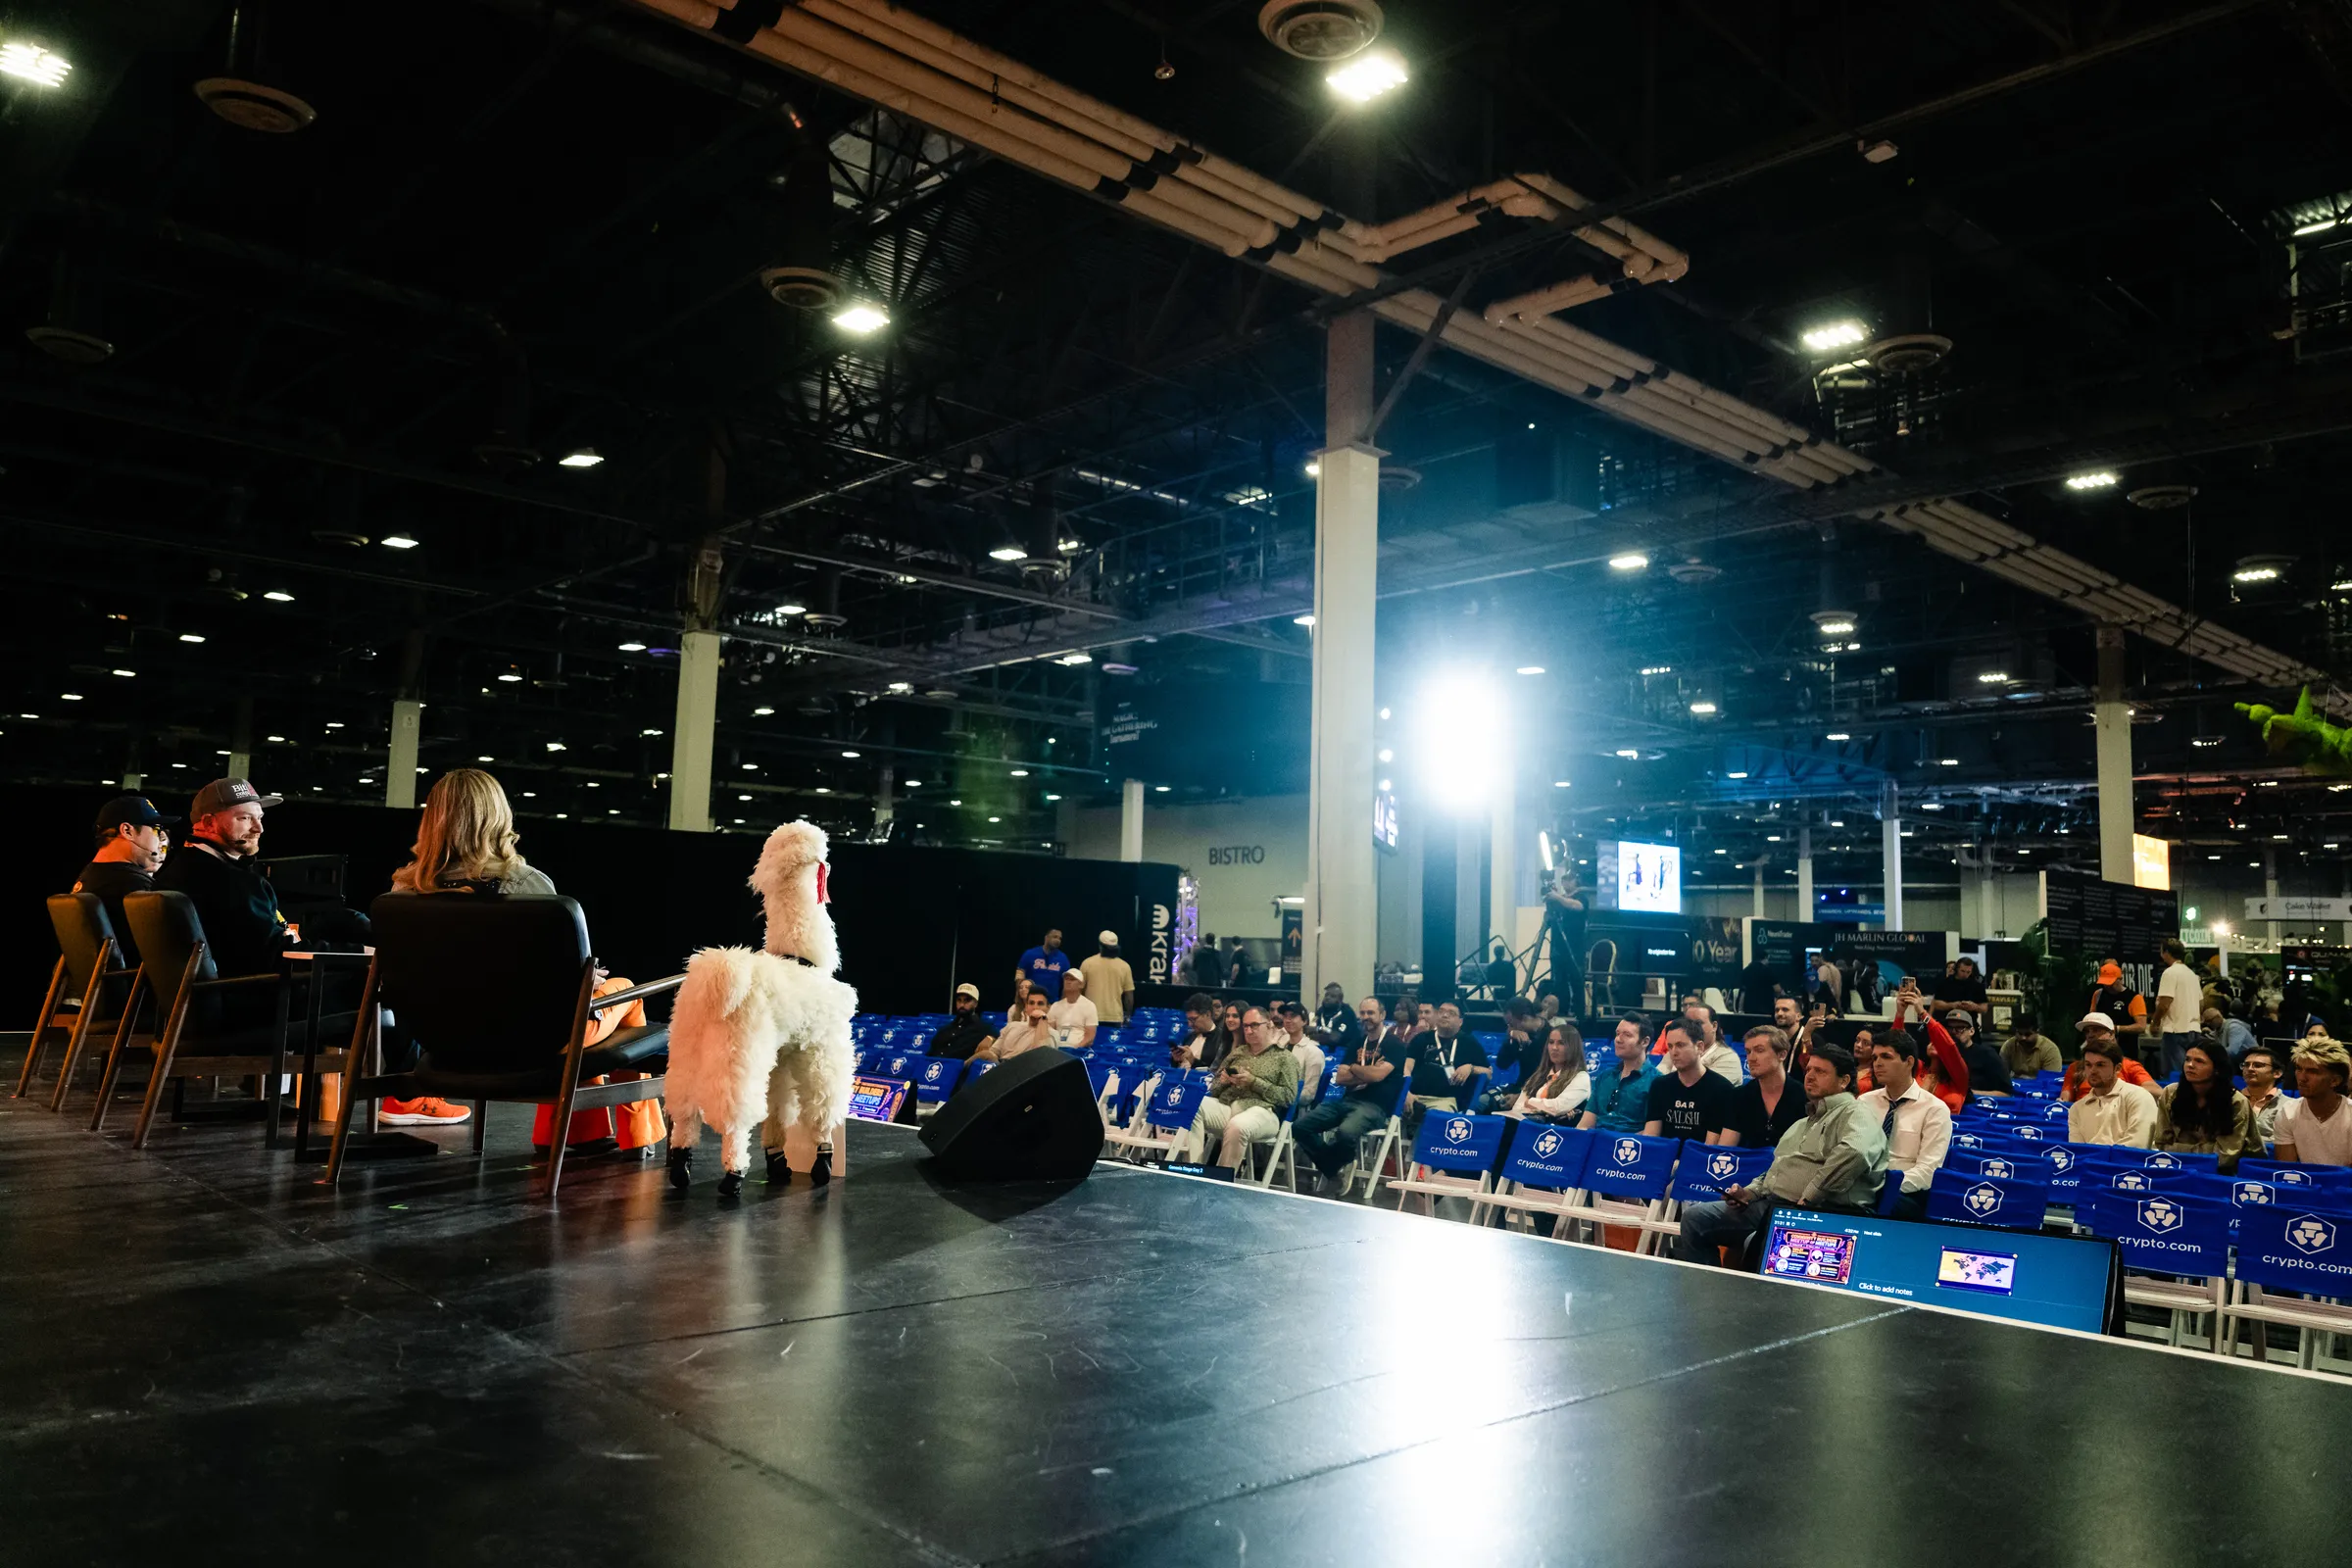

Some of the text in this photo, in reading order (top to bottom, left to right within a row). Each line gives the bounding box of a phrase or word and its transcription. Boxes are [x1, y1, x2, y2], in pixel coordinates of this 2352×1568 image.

[1208, 845, 1265, 865] BISTRO
[2285, 902, 2306, 910] Cake
[1835, 933, 1927, 943] JH MARLIN GLOAL
[1707, 940, 1739, 963] Year
[2137, 963, 2154, 998] DIE
[854, 1094, 881, 1105] MEETUPS
[1675, 1100, 1695, 1109] BAR
[1430, 1146, 1478, 1156] crypto.com
[1516, 1157, 1563, 1173] crypto.com
[1595, 1166, 1645, 1181] crypto.com
[2117, 1234, 2202, 1253] crypto.com
[2262, 1254, 2352, 1275] crypto.com
[1858, 1282, 1874, 1291] Click
[1895, 1288, 1913, 1297] notes
